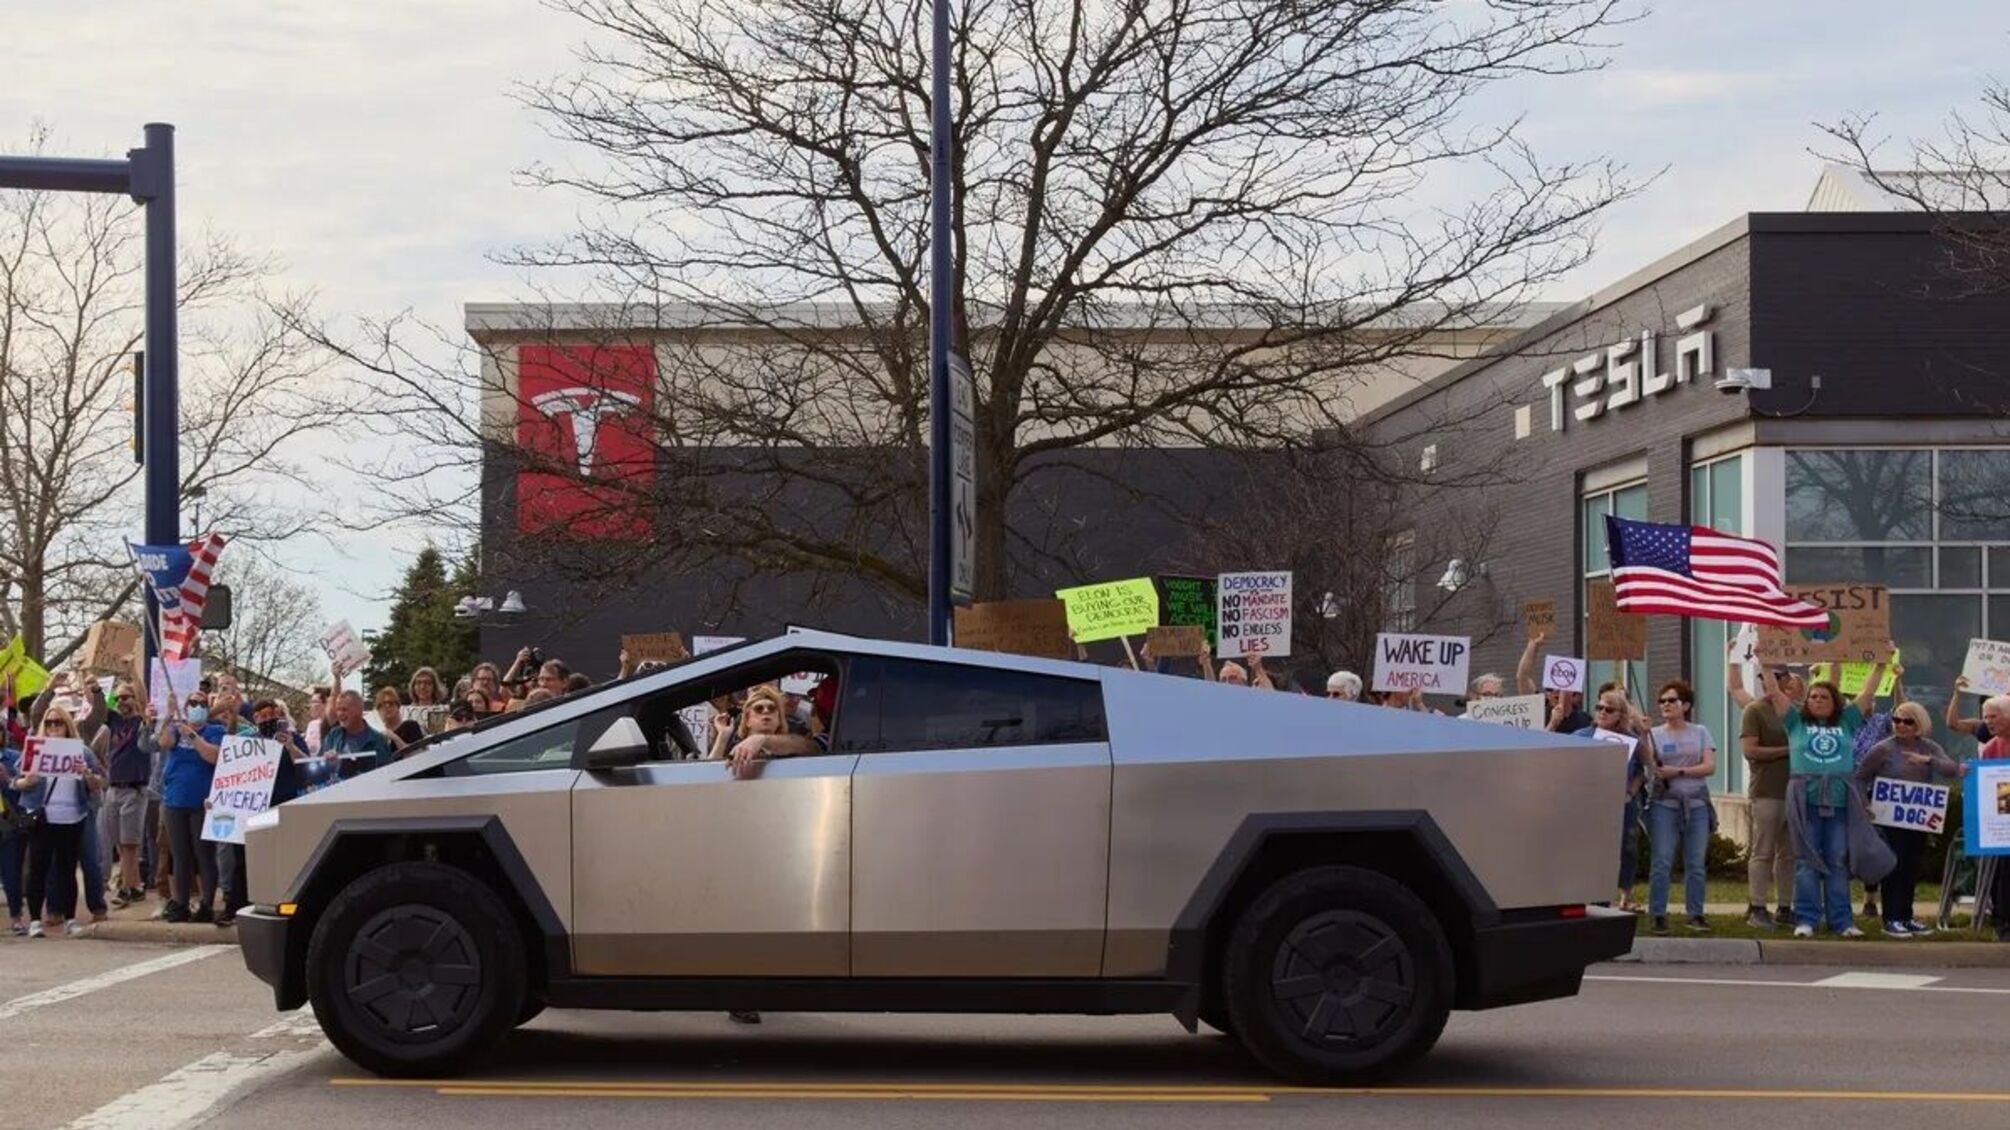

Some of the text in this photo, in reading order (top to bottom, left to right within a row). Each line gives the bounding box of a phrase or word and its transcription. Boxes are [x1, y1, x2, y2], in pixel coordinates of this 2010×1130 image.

[1543, 303, 1714, 431] TESLA
[1224, 575, 1287, 590] DEMOCRACY
[1222, 594, 1287, 609] NO MANDATE
[1222, 608, 1289, 622] NO FASCISM
[1222, 625, 1240, 639] NO
[1243, 623, 1282, 636] ENDLESS
[1239, 637, 1269, 653] LIES
[1384, 637, 1464, 666] WAKE UP
[1386, 671, 1441, 687] AMERICA
[1472, 703, 1531, 719] CONGRESS
[222, 739, 266, 763] ELON
[213, 791, 269, 813] AMERICA
[1875, 781, 1946, 808] BEWARE
[1893, 805, 1943, 830] DOGE
